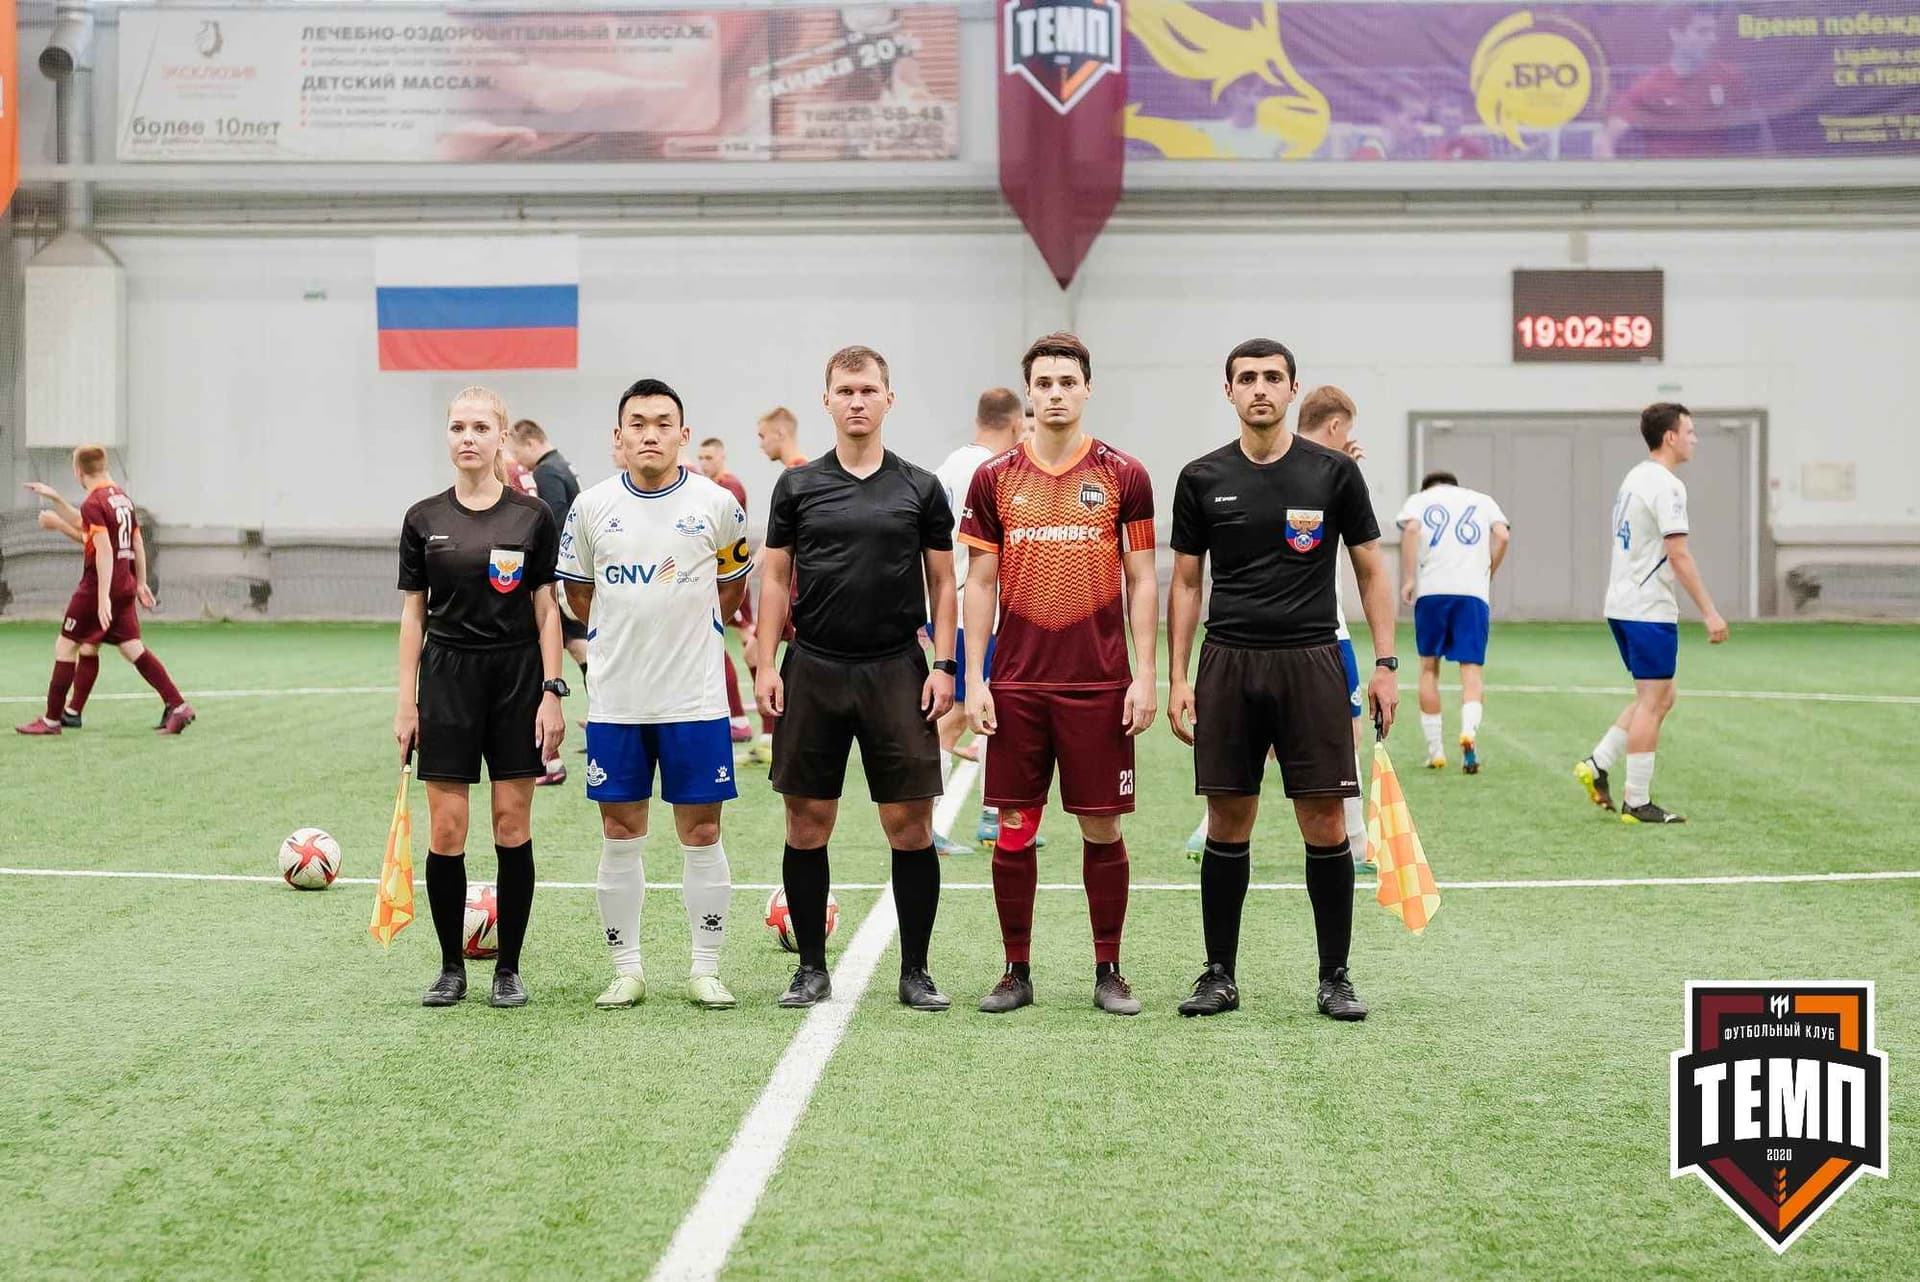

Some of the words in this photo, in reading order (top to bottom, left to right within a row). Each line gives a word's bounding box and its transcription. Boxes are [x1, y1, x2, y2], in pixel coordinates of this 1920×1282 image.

[1016, 6, 1110, 57] ТЕМП
[302, 75, 395, 91] ДЕТСКИЙ
[132, 117, 205, 136] более
[215, 117, 281, 136] 10лет
[1517, 315, 1653, 348] 19:02:59
[1423, 503, 1481, 548] 96
[606, 564, 656, 584] GNV
[1119, 769, 1134, 796] 23
